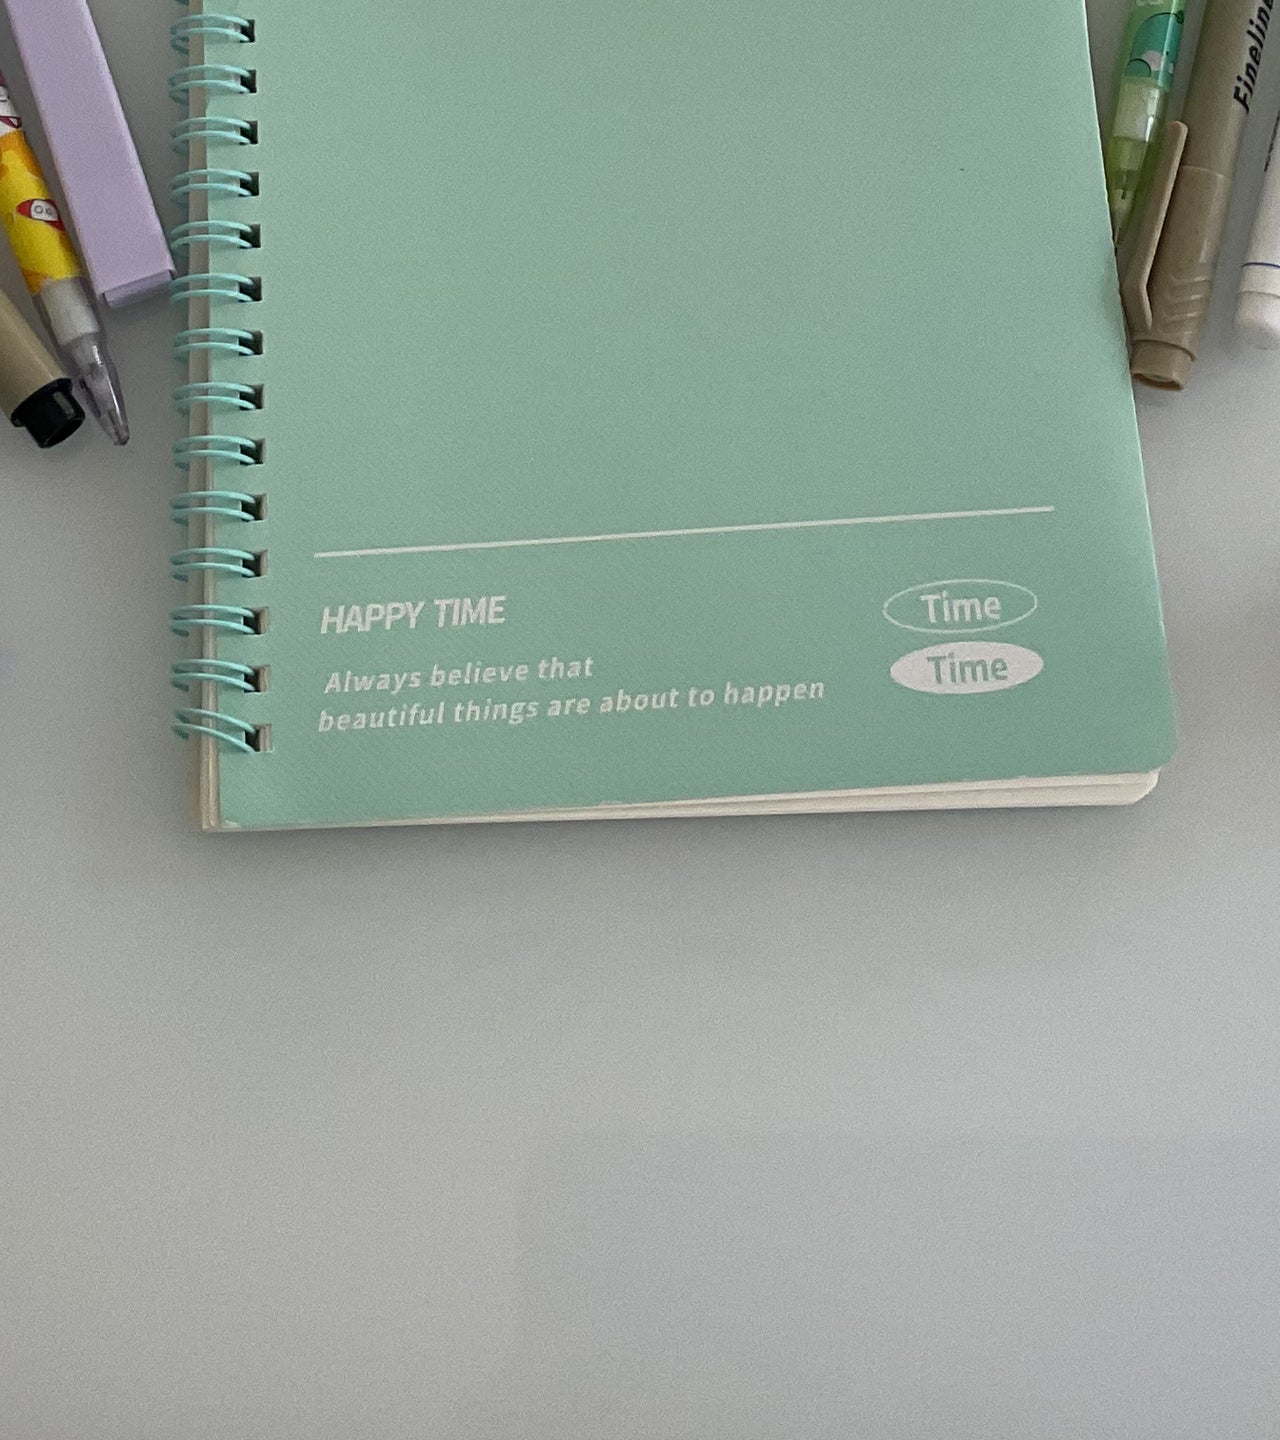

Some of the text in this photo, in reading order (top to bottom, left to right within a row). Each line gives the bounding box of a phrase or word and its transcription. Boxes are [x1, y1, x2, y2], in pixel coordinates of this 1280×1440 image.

[320, 595, 506, 635] HAPPY TIME
[919, 591, 1002, 624] Time
[323, 655, 595, 695] Always believe that
[927, 652, 1009, 685] Time
[317, 678, 826, 734] beautiful things are about to happen
